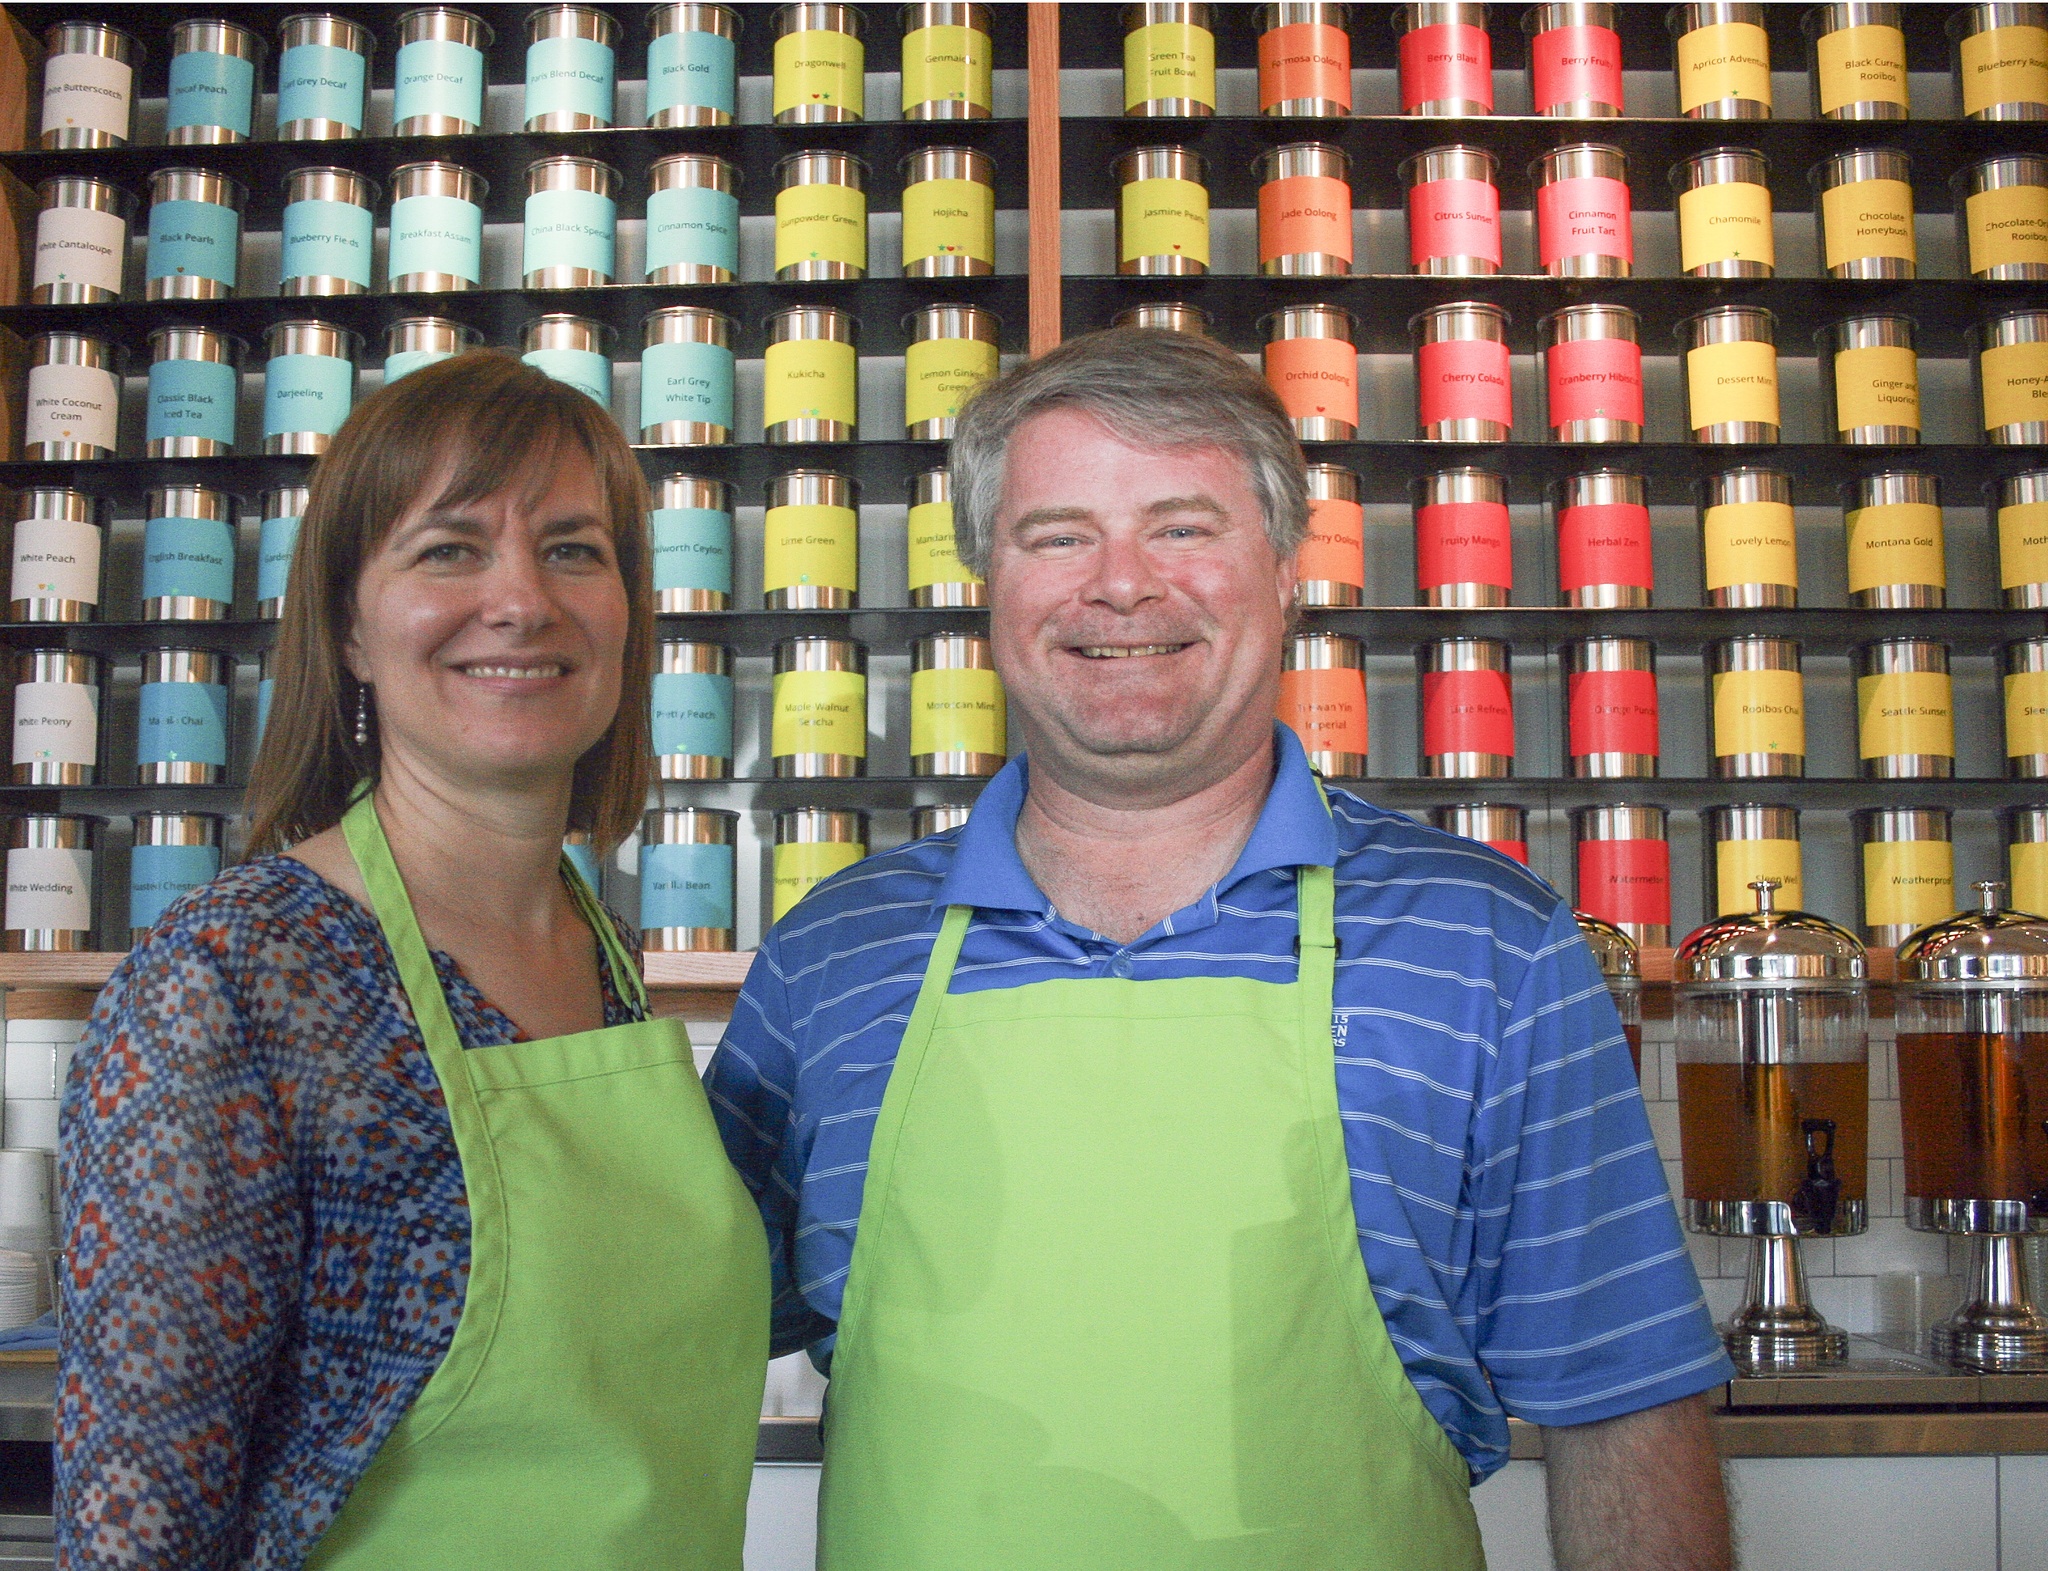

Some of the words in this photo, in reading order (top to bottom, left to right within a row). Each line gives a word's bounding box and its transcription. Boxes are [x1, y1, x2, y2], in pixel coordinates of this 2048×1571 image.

[1149, 52, 1177, 62] Green
[1180, 52, 1196, 62] Tea
[1272, 56, 1311, 68] Formosa
[1313, 55, 1343, 71] Oolong
[1427, 54, 1453, 64] Berry
[1456, 53, 1478, 65] Blast
[1561, 57, 1588, 67] Berry
[794, 60, 847, 70] Dragonwell
[1692, 56, 1727, 71] Apricot
[1845, 59, 1872, 70] Black
[1977, 60, 2027, 73] Blueberry
[662, 66, 686, 76] Black
[688, 64, 710, 74] Gold
[1174, 67, 1196, 78] Bowl
[403, 75, 433, 87] Orange
[437, 73, 464, 84] Decaf
[550, 70, 577, 79] Blend
[579, 71, 604, 84] Decaf
[1860, 72, 1897, 83] Rooibos
[198, 84, 228, 95] Peach
[297, 78, 318, 90] Grey
[320, 77, 348, 90] Decaf
[62, 83, 123, 100] Butterscotch
[932, 208, 969, 219] Hojicha
[1143, 208, 1182, 219] Jasmine
[1280, 209, 1302, 220] Jade
[1304, 208, 1338, 222] Oolong
[1434, 211, 1463, 222] Citrus
[1465, 211, 1493, 225] Sunset
[1568, 210, 1618, 220] Cinnamon
[1858, 212, 1905, 222] Chocolate
[832, 214, 859, 227] Green
[1708, 215, 1761, 225] Chamomile
[531, 225, 553, 236] China
[555, 223, 581, 233] Black
[656, 221, 703, 233] Cinnamon
[705, 223, 728, 235] Spice
[1571, 226, 1595, 236] Fruit
[1597, 226, 1617, 236] Tart
[1856, 226, 1909, 237] Honeybush
[184, 233, 215, 246] Pearls
[290, 234, 332, 245] Blueberry
[333, 234, 360, 249] Fieds
[400, 230, 442, 241] Breakfast
[444, 230, 472, 244] Assam
[58, 239, 113, 256] Cantaloupe
[787, 370, 826, 380] Kukicha
[920, 369, 951, 381] Lemon
[1285, 371, 1319, 382] Orchid
[1321, 371, 1350, 387] Oolong
[1441, 373, 1475, 384] Cherry
[1558, 372, 1607, 386] Cranberry
[1716, 375, 1755, 386] Dessert
[667, 377, 686, 387] Earl
[688, 377, 711, 388] Grey
[1872, 379, 1903, 391] Ginger
[187, 393, 214, 405] Black
[276, 388, 324, 400] Darjeeling
[665, 393, 694, 403] White
[697, 394, 711, 405] Tip
[62, 397, 102, 411] Coconut
[50, 410, 83, 421] Cream
[164, 409, 183, 420] Iced
[184, 410, 203, 420] Tea
[780, 537, 803, 547] Lime
[805, 535, 836, 546] Green
[1440, 535, 1470, 547] Fruity
[1587, 537, 1622, 548] Herbal
[1622, 537, 1640, 547] Zen
[1729, 537, 1762, 547] Lovely
[1764, 537, 1791, 547] Lemon
[1865, 538, 1911, 550] Montana
[1913, 537, 1934, 547] Gold
[46, 553, 76, 564] Peach
[177, 552, 223, 566] Breakfast
[1338, 703, 1354, 712] Yin
[1741, 703, 1783, 715] Rooibos
[1881, 706, 1917, 718] Seattle
[687, 709, 717, 721] Peach
[41, 716, 73, 729] Peony
[799, 717, 834, 728] Secha
[29, 883, 74, 896] Wedding
[685, 880, 711, 891] Bean
